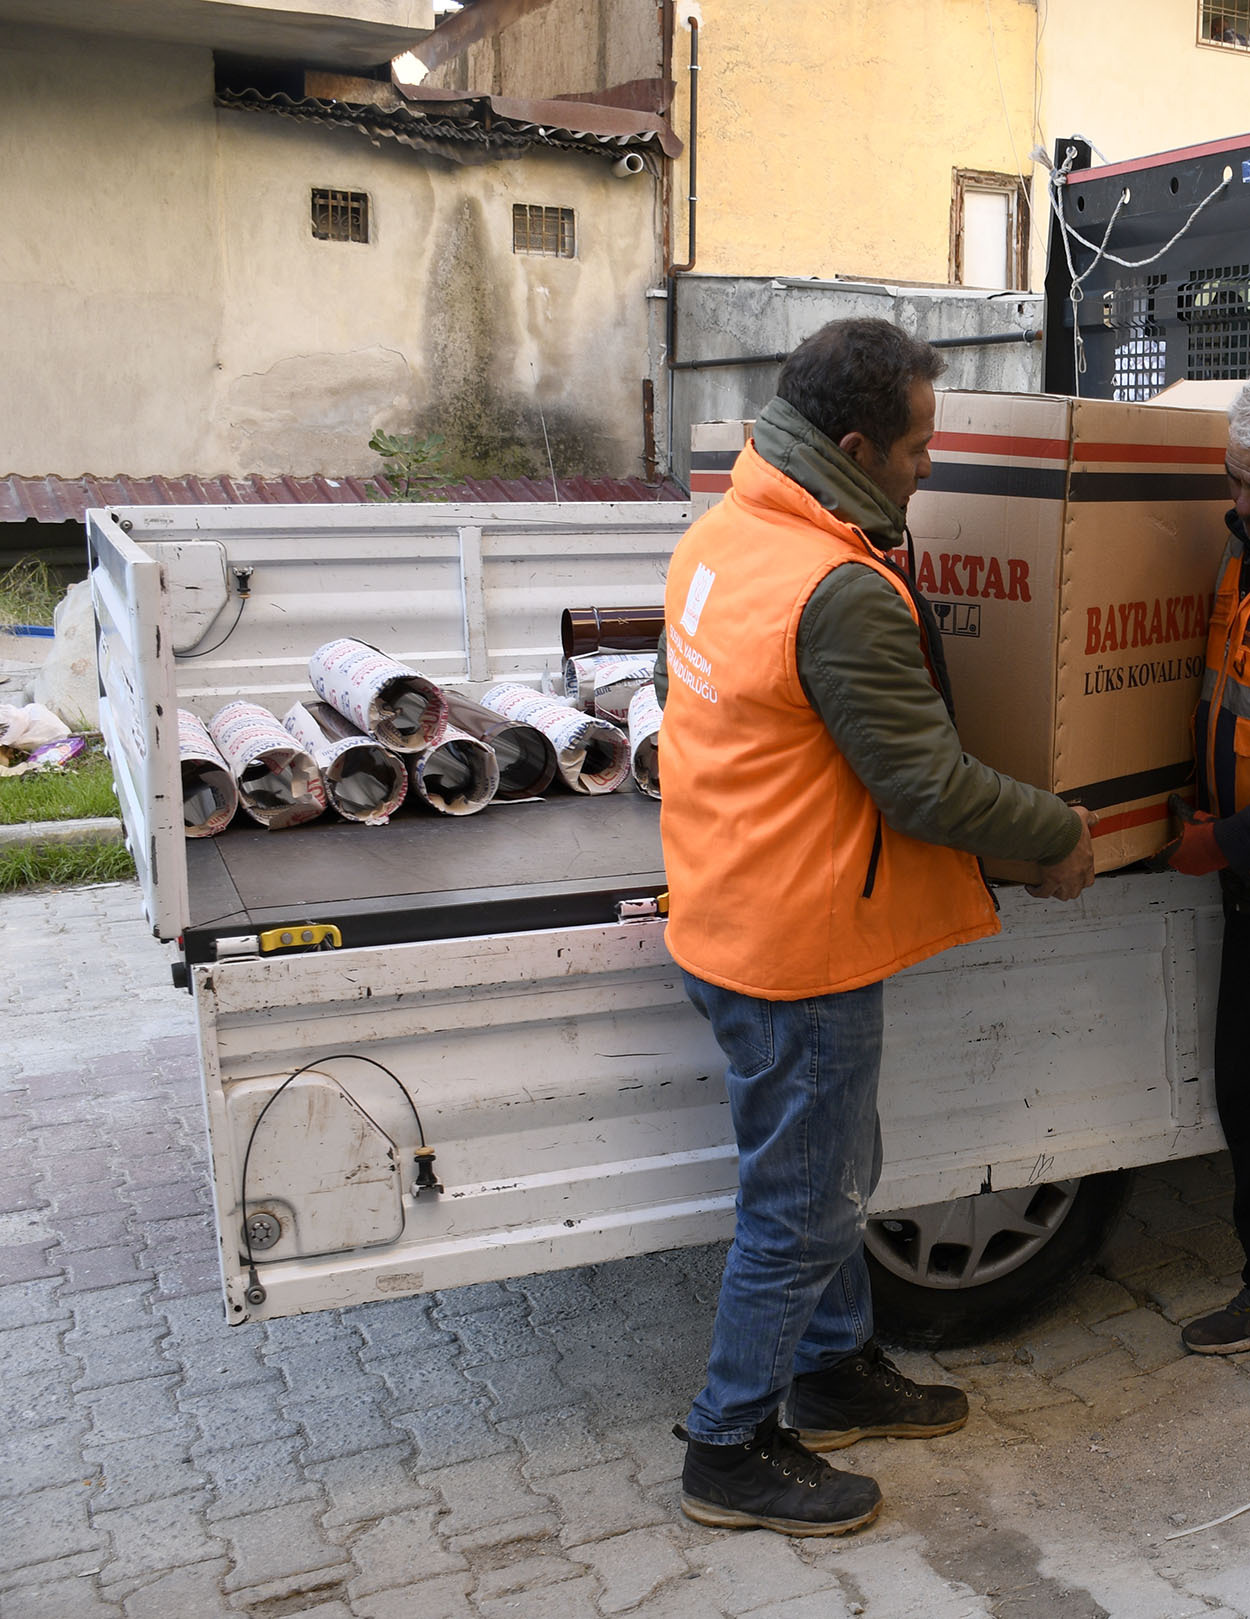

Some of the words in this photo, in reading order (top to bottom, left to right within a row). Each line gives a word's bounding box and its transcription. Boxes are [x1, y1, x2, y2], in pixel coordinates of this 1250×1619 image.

[884, 548, 1032, 602] RAKTAR
[684, 641, 712, 678] YARDIM
[1084, 664, 1124, 696] LÜKS
[1128, 658, 1182, 689] KOVALI
[1184, 655, 1207, 684] SO
